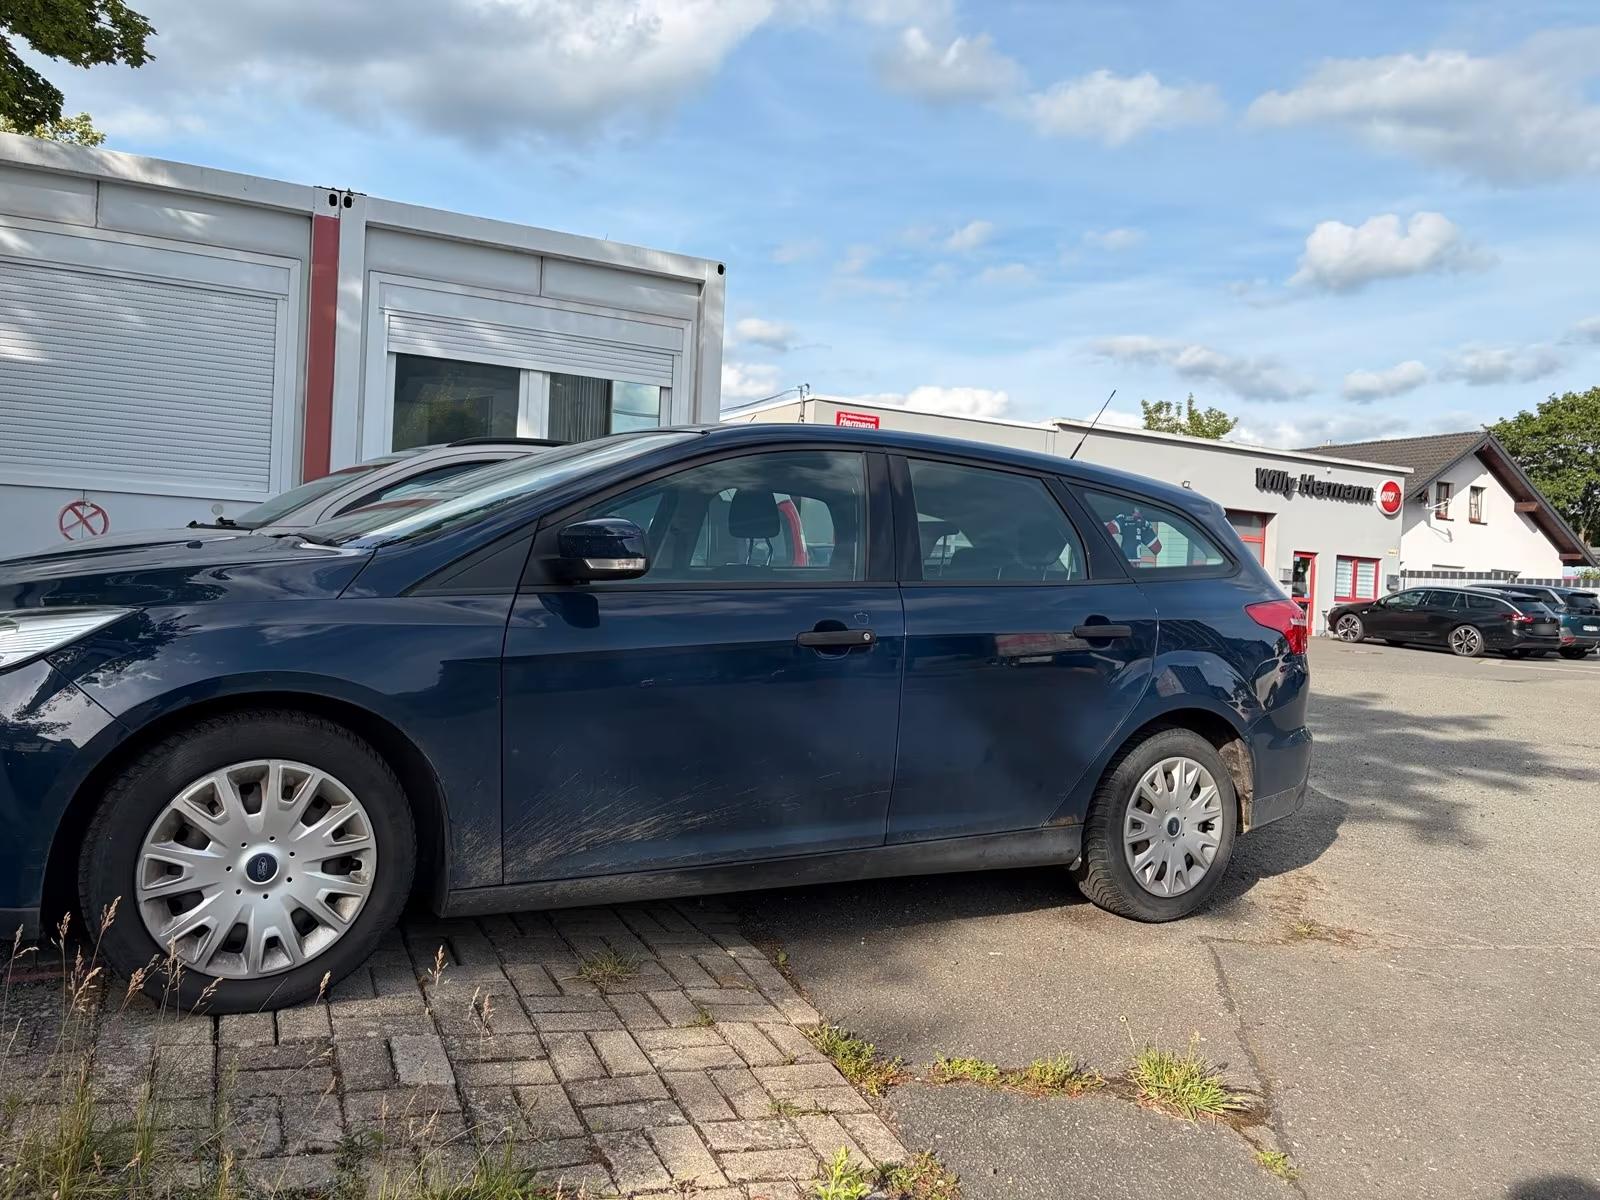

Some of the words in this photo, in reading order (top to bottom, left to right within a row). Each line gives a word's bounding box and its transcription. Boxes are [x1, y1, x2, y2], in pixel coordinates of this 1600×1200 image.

[840, 417, 876, 429] Hermann
[1255, 467, 1298, 495] Willy
[1299, 474, 1374, 503] Hermann
